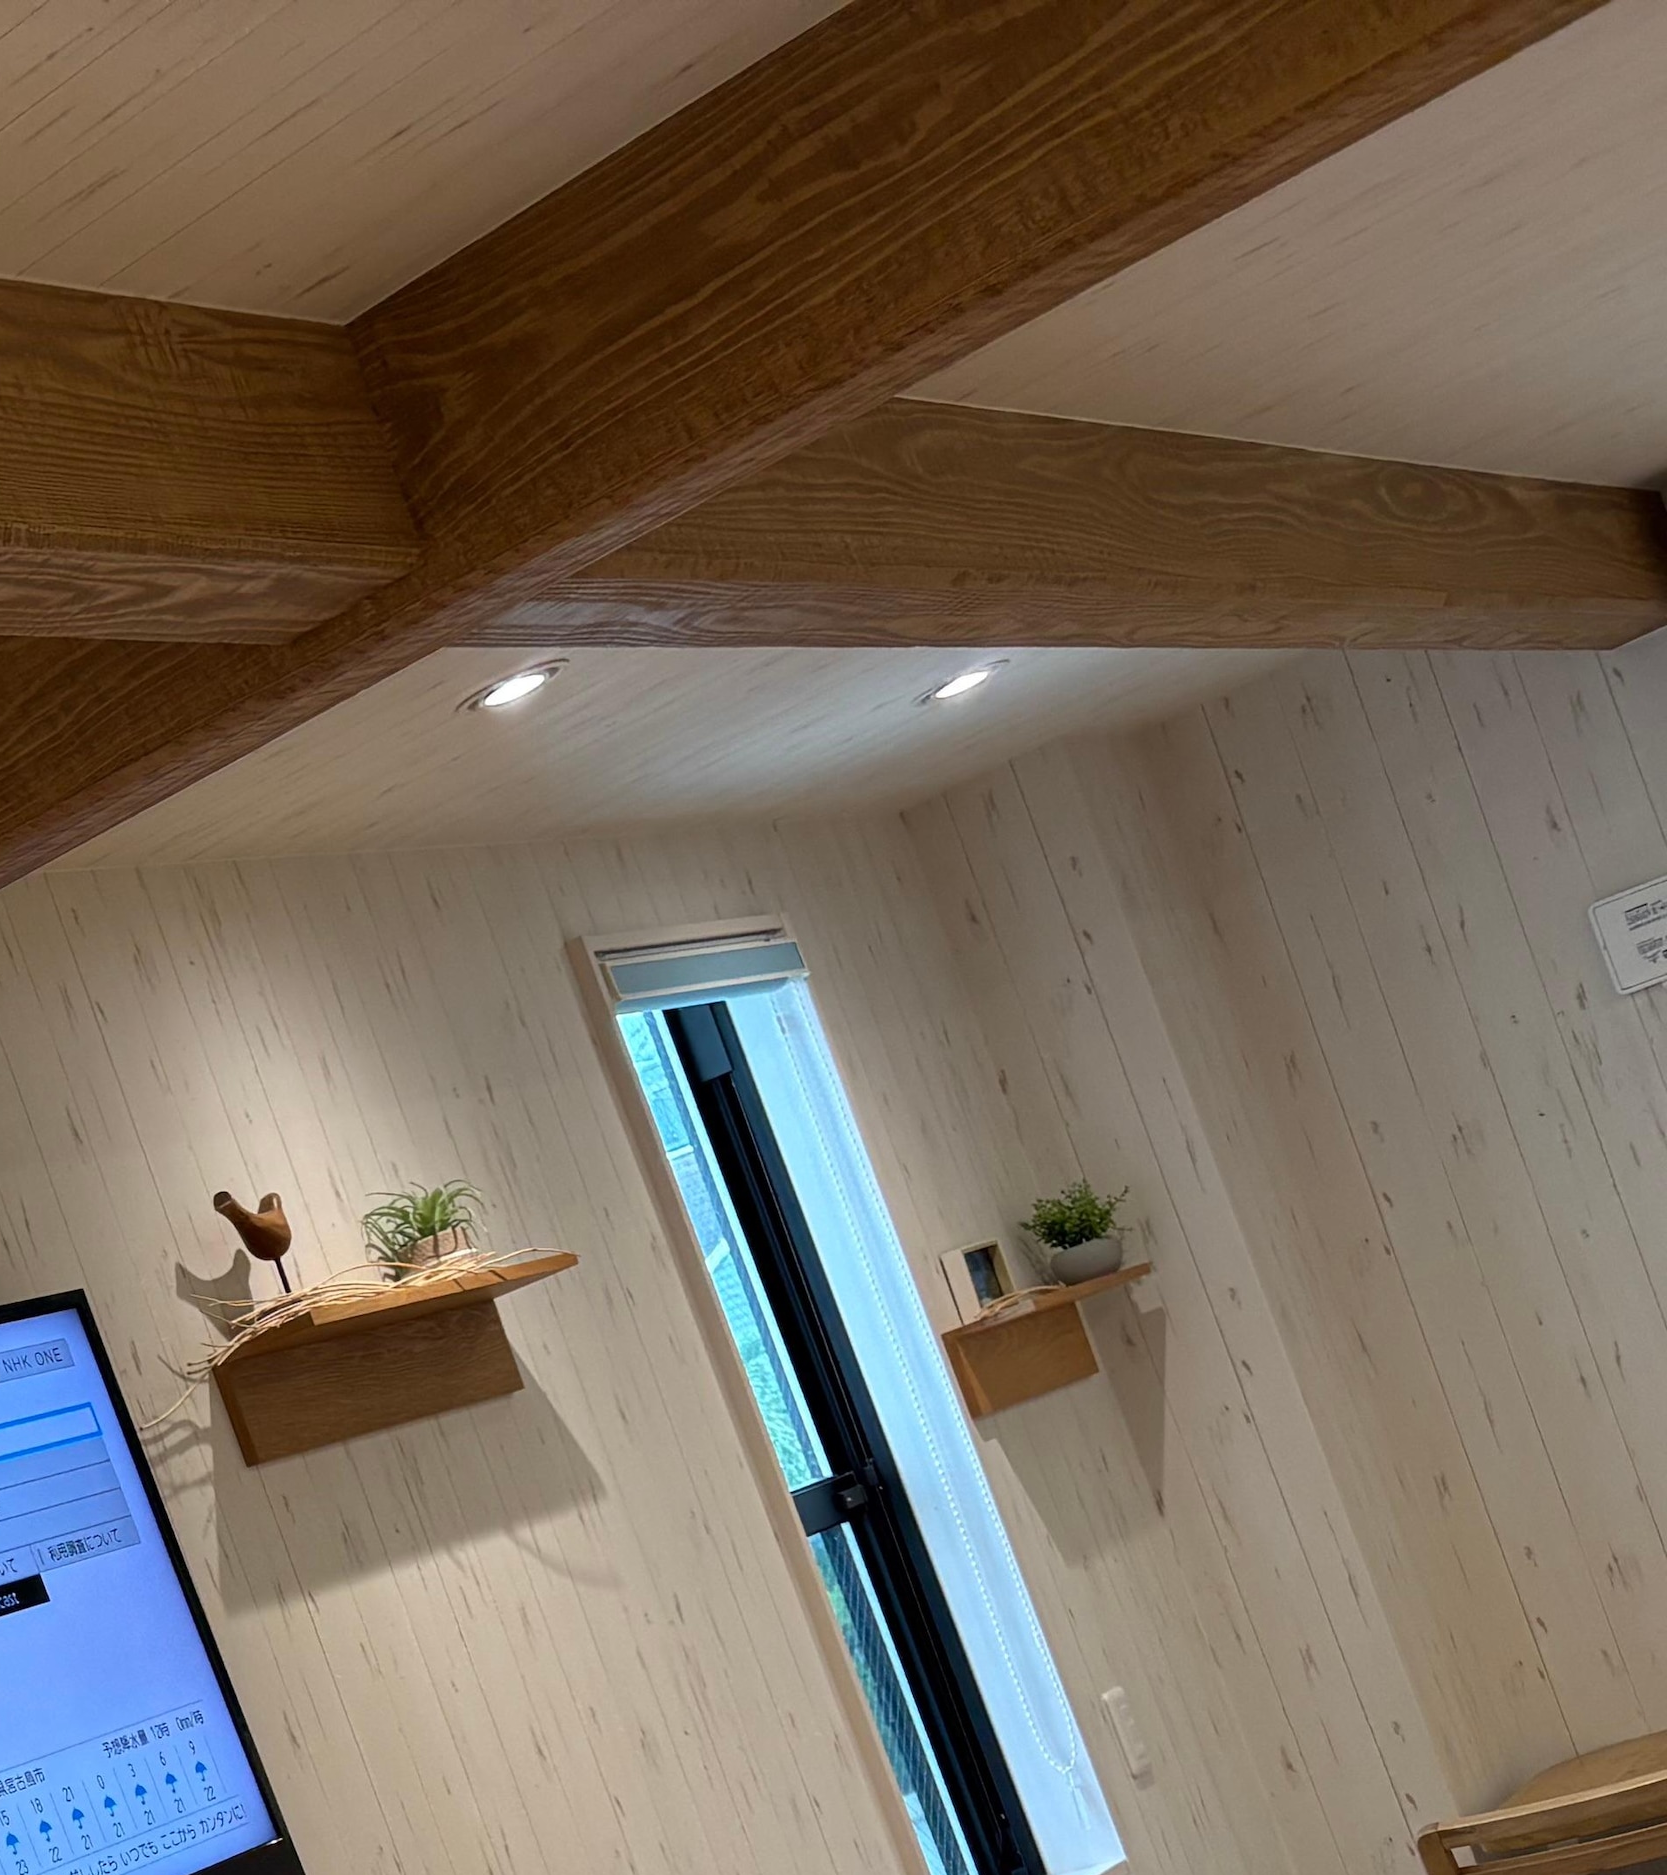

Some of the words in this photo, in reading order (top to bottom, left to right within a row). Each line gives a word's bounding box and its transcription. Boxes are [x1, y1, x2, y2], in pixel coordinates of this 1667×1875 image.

[1, 1354, 33, 1374] NHK
[34, 1347, 63, 1366] ONE
[47, 1528, 122, 1562] 利用調査について
[101, 1728, 149, 1759] 予想降水量
[29, 1797, 44, 1814] 18
[61, 1786, 75, 1803] 21
[96, 1774, 105, 1790] 0
[127, 1762, 137, 1778] 3
[159, 1751, 167, 1767] 6
[188, 1740, 196, 1755] 9
[15, 1858, 29, 1875] 23
[48, 1846, 63, 1863] 22
[80, 1834, 94, 1851] 21
[112, 1821, 126, 1838] 21
[143, 1809, 156, 1826] 21
[173, 1797, 187, 1814] 21
[203, 1785, 217, 1802] 22
[119, 1841, 159, 1867] いつでも
[159, 1824, 197, 1850] ここから
